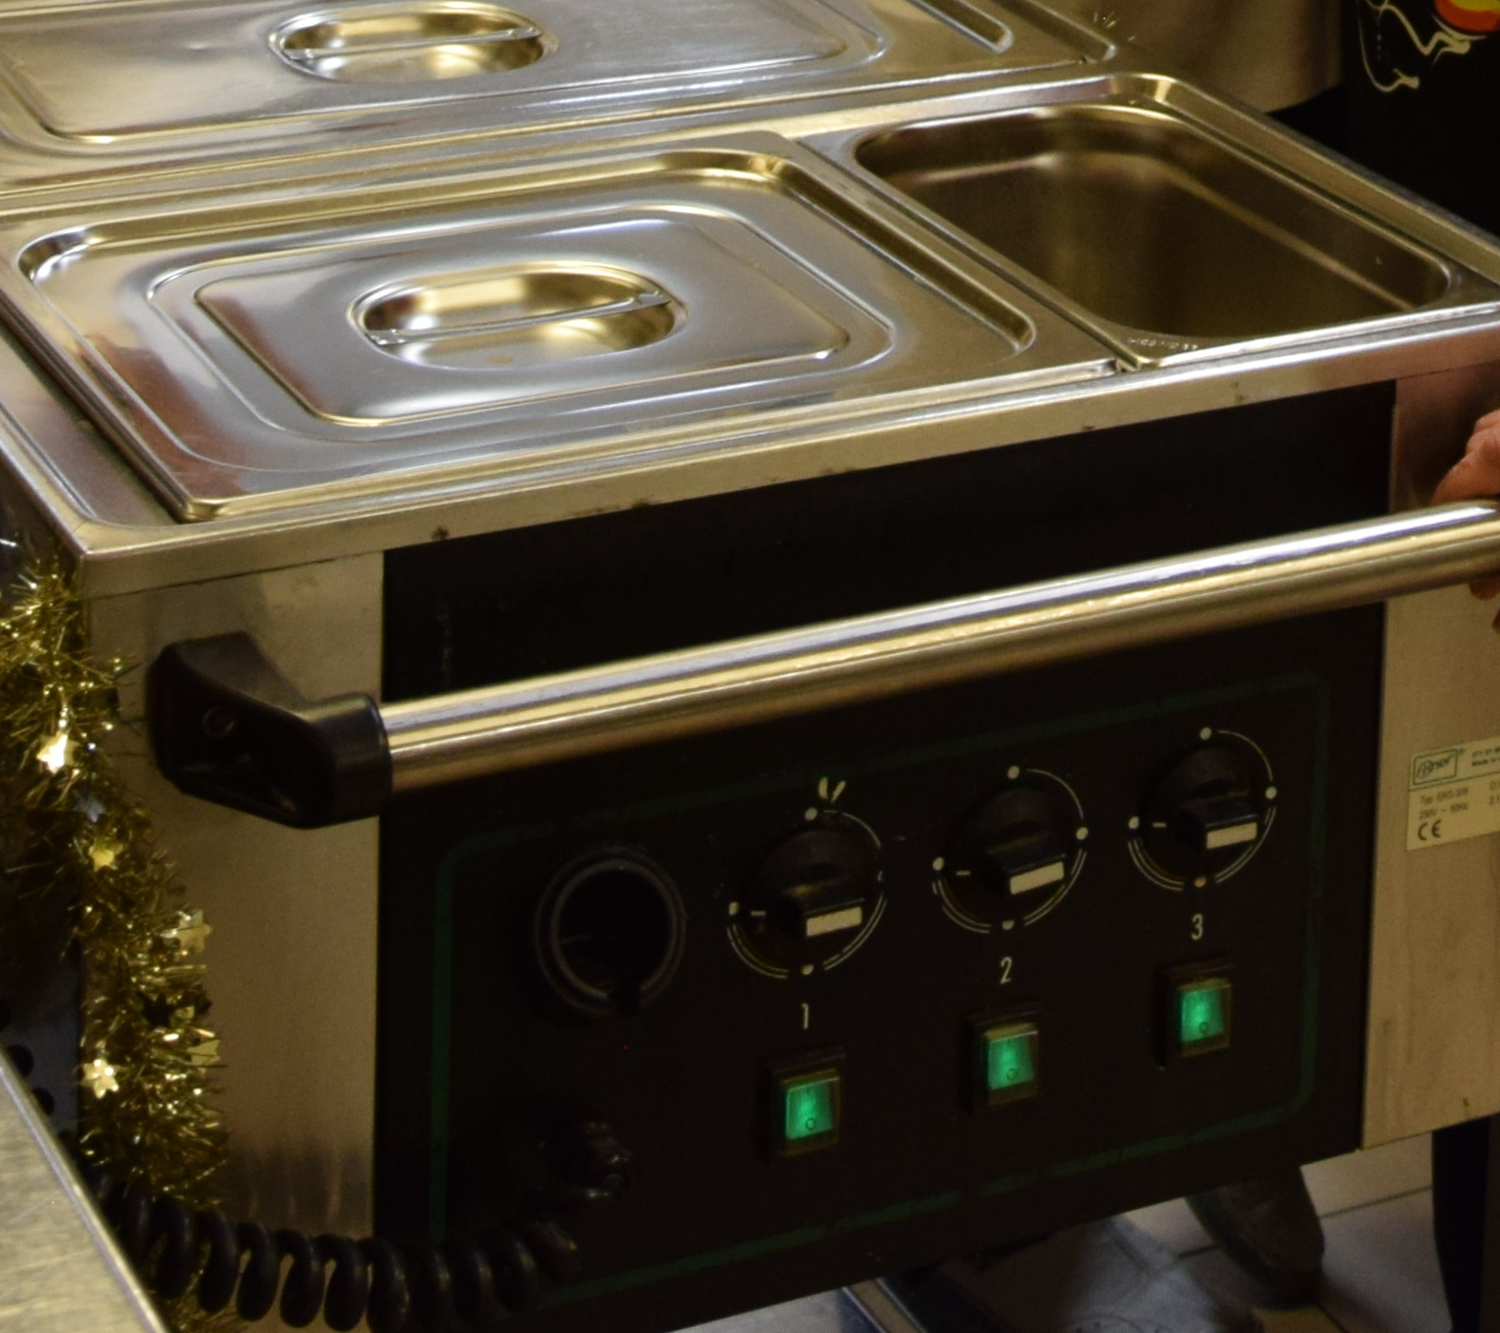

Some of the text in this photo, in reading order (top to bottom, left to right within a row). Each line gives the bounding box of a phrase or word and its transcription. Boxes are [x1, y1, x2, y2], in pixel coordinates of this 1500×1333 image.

[1190, 913, 1204, 942] 3
[999, 956, 1013, 985] 2
[799, 1002, 810, 1031] 1
